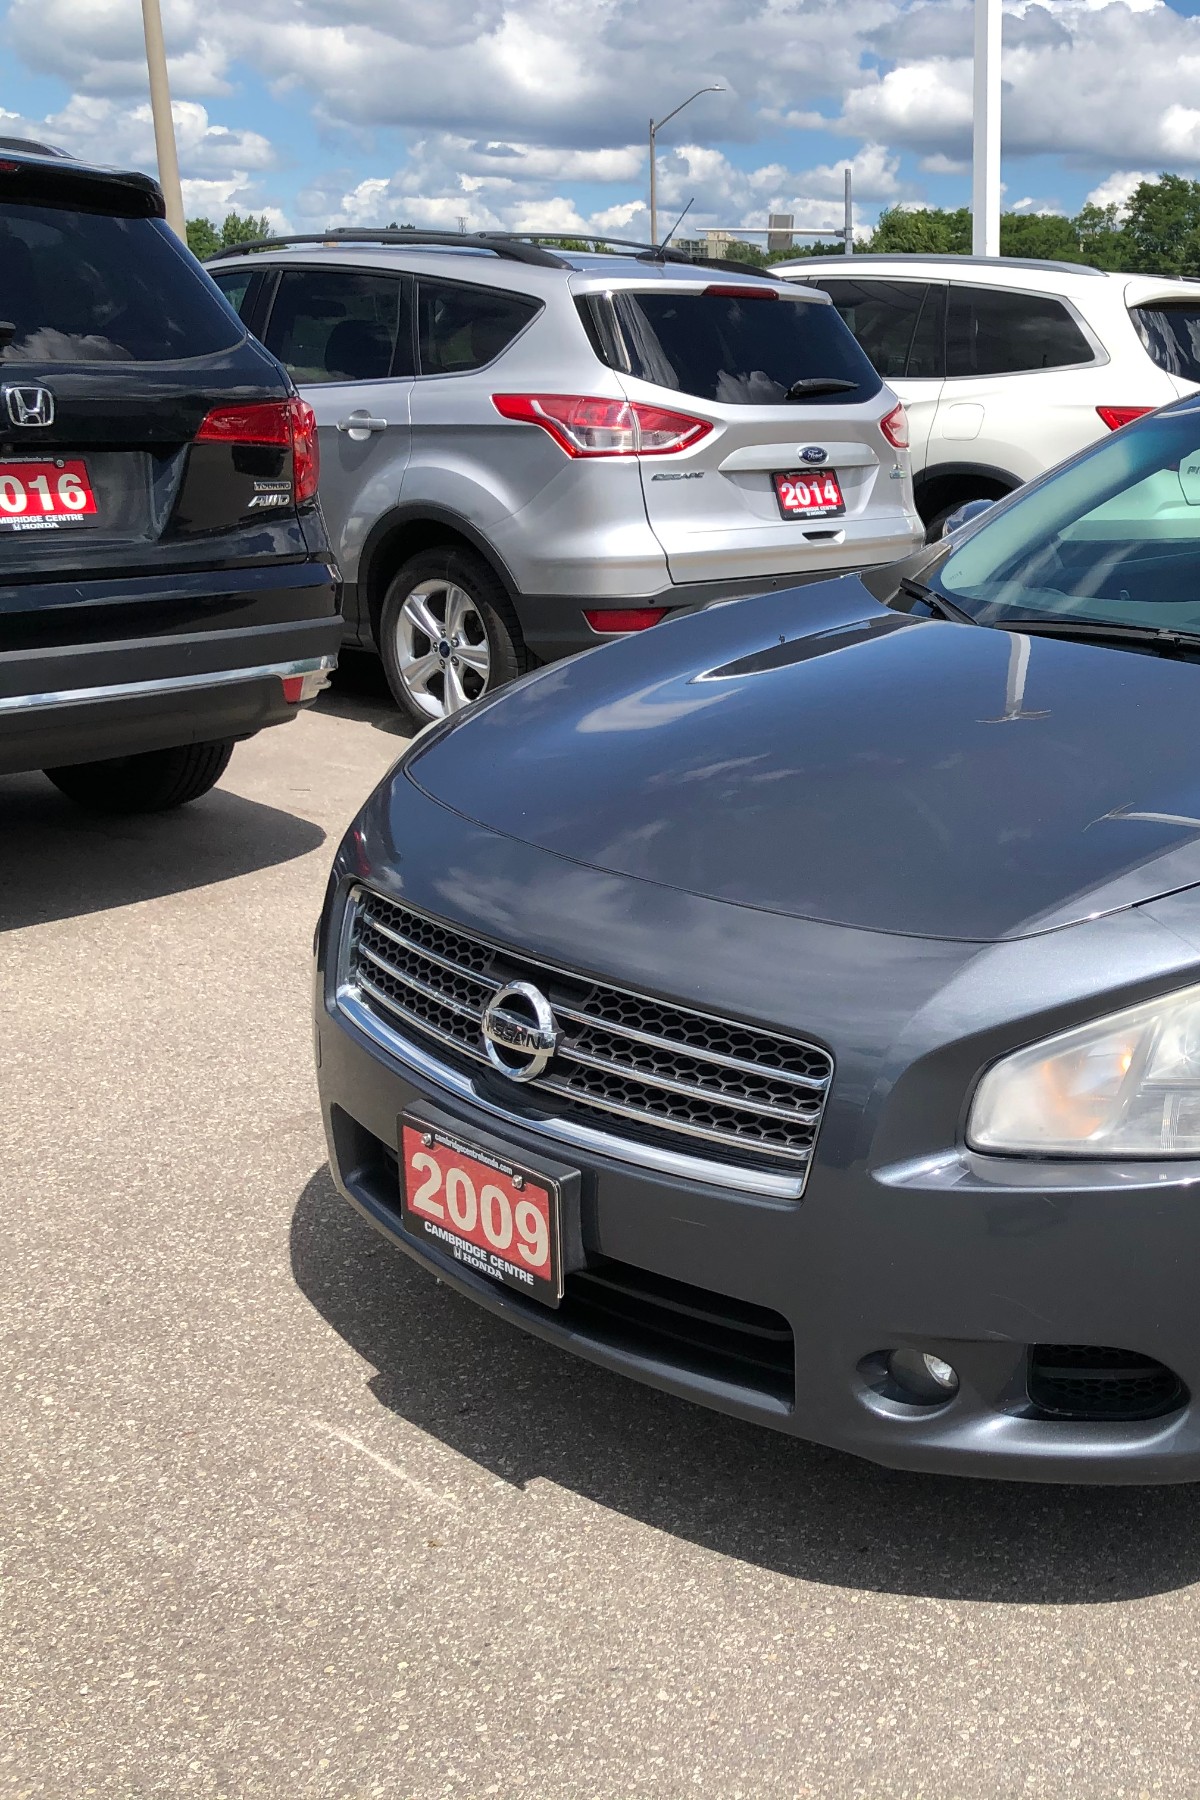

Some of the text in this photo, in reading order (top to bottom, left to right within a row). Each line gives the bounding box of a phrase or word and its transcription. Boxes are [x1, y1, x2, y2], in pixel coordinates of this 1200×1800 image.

[248, 494, 290, 507] AWD
[781, 480, 838, 507] 2014
[22, 522, 60, 530] HONDA
[45, 513, 84, 522] CENTRE
[435, 1134, 513, 1175] cambridgecentrehonda.com
[411, 1152, 549, 1267] 2009
[424, 1221, 535, 1286] CAMBRIDGE CENTRE
[463, 1252, 504, 1281] HONDA
